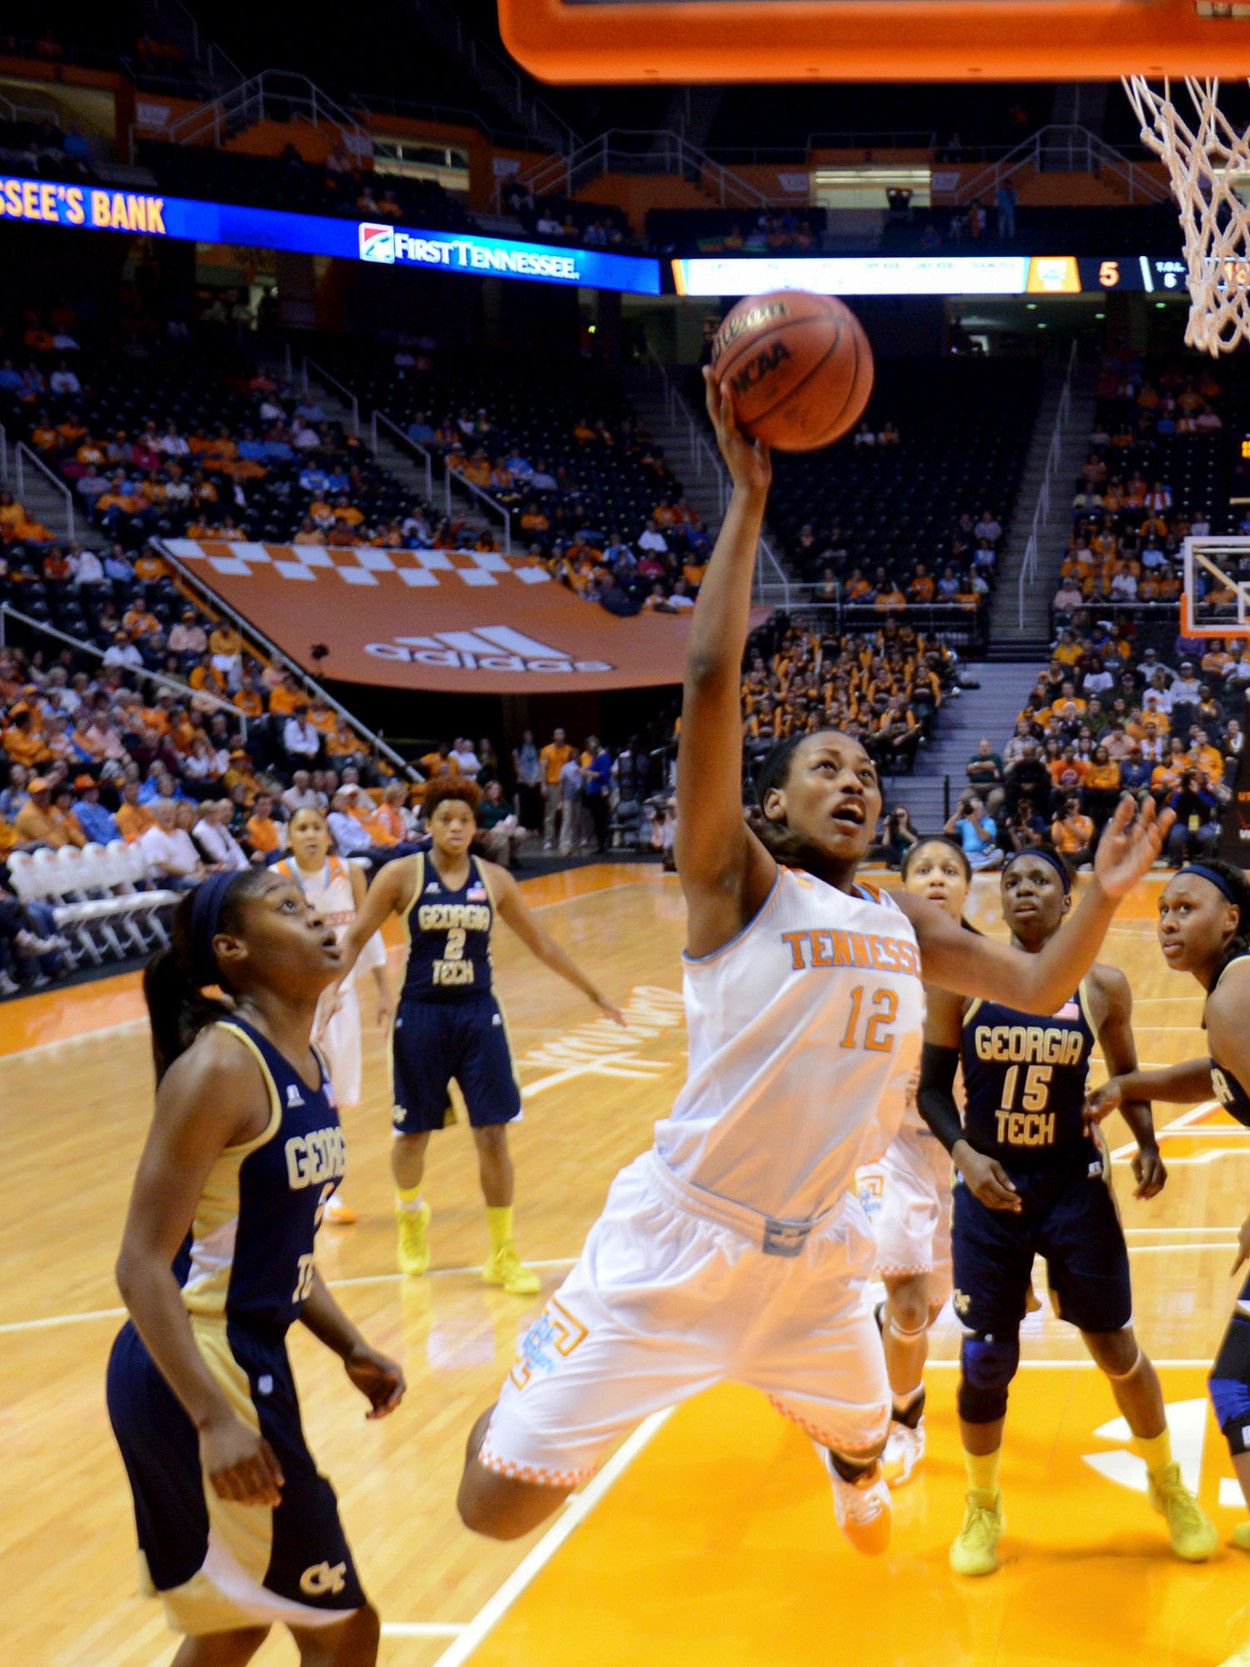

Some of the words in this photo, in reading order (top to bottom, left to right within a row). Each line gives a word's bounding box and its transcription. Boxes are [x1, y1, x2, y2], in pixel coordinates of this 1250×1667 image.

[0, 178, 85, 225] SEE'S
[91, 190, 166, 234] BANK
[394, 232, 454, 264] FIRST
[451, 240, 576, 279] TENNESSEE
[1099, 261, 1120, 287] 5
[364, 642, 614, 673] adidas
[418, 904, 491, 932] GEORGIA
[443, 926, 467, 960] 2
[432, 959, 475, 985] TECH
[839, 985, 900, 1052] 12
[975, 1025, 1084, 1065] GEORGIA
[1001, 1065, 1053, 1112] 15
[995, 1109, 1056, 1146] TECH
